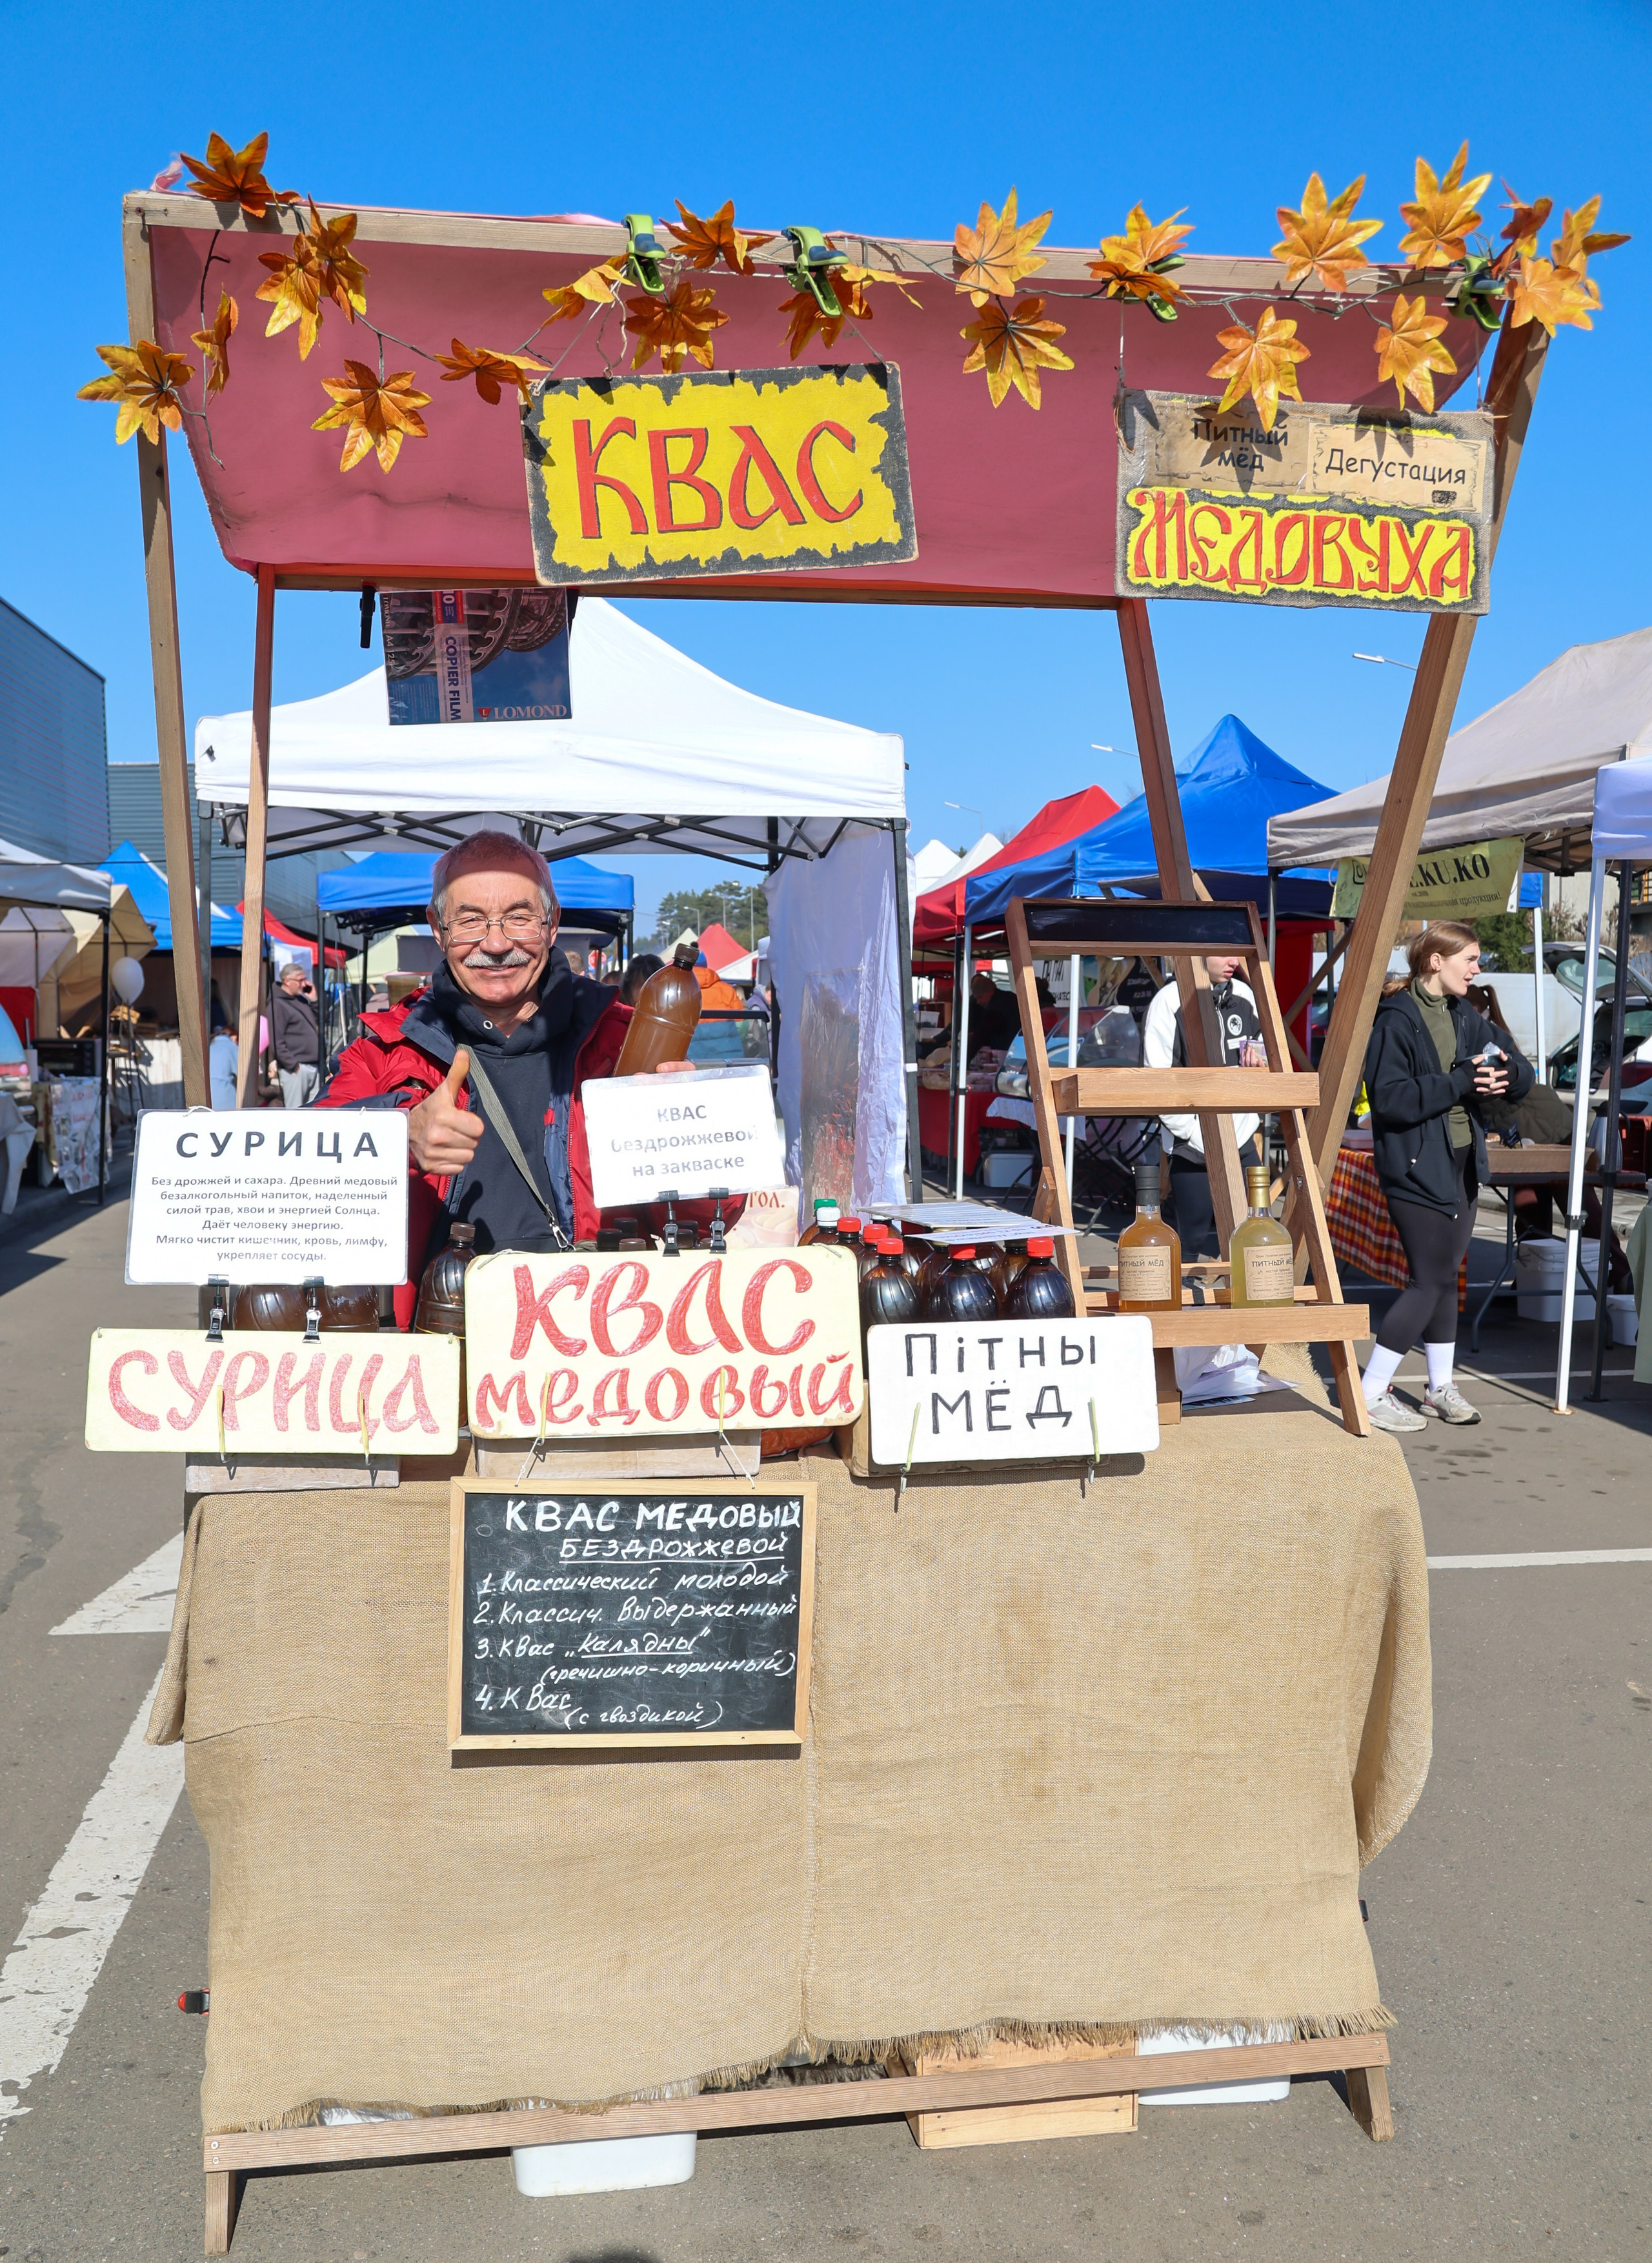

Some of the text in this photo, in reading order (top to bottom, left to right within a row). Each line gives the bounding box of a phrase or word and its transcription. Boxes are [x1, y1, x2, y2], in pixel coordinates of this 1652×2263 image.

[1191, 418, 1289, 447] Питный
[1217, 448, 1264, 472] мёд
[1325, 448, 1466, 485] Дегустация
[572, 416, 863, 539] КВАС
[1134, 490, 1471, 598] МЕДОВУХА
[445, 636, 461, 721] COPIER FILM
[494, 705, 567, 719] LOMOND
[658, 1105, 707, 1122] КВАС
[176, 1131, 379, 1163] СУРИЦА
[632, 1156, 745, 1176] на закваске
[152, 1177, 171, 1185] Без
[175, 1176, 230, 1187] дрожжей
[289, 1176, 341, 1187] Древний
[344, 1177, 398, 1185] медовый
[161, 1190, 387, 1202] безалкогольный напиток, наделенный
[166, 1205, 201, 1214] силой
[205, 1207, 234, 1216] трав,
[279, 1205, 331, 1216] энергией
[335, 1206, 379, 1216] Солнца.
[202, 1220, 343, 1231] Даёт человеку энергию.
[156, 1235, 194, 1244] Мягко
[305, 1238, 341, 1247] кровь,
[345, 1237, 387, 1247] лимфу,
[217, 1252, 326, 1262] укрепляет сосуды.
[1252, 1258, 1284, 1267] ПИТНЫЙ
[509, 1258, 815, 1360] КВАС
[108, 1348, 441, 1445] СУРИЦА
[931, 1380, 1073, 1434] МЁД
[505, 1500, 801, 1532] КВАС МЕДОВЫЙ
[674, 1562, 789, 1591] молодой
